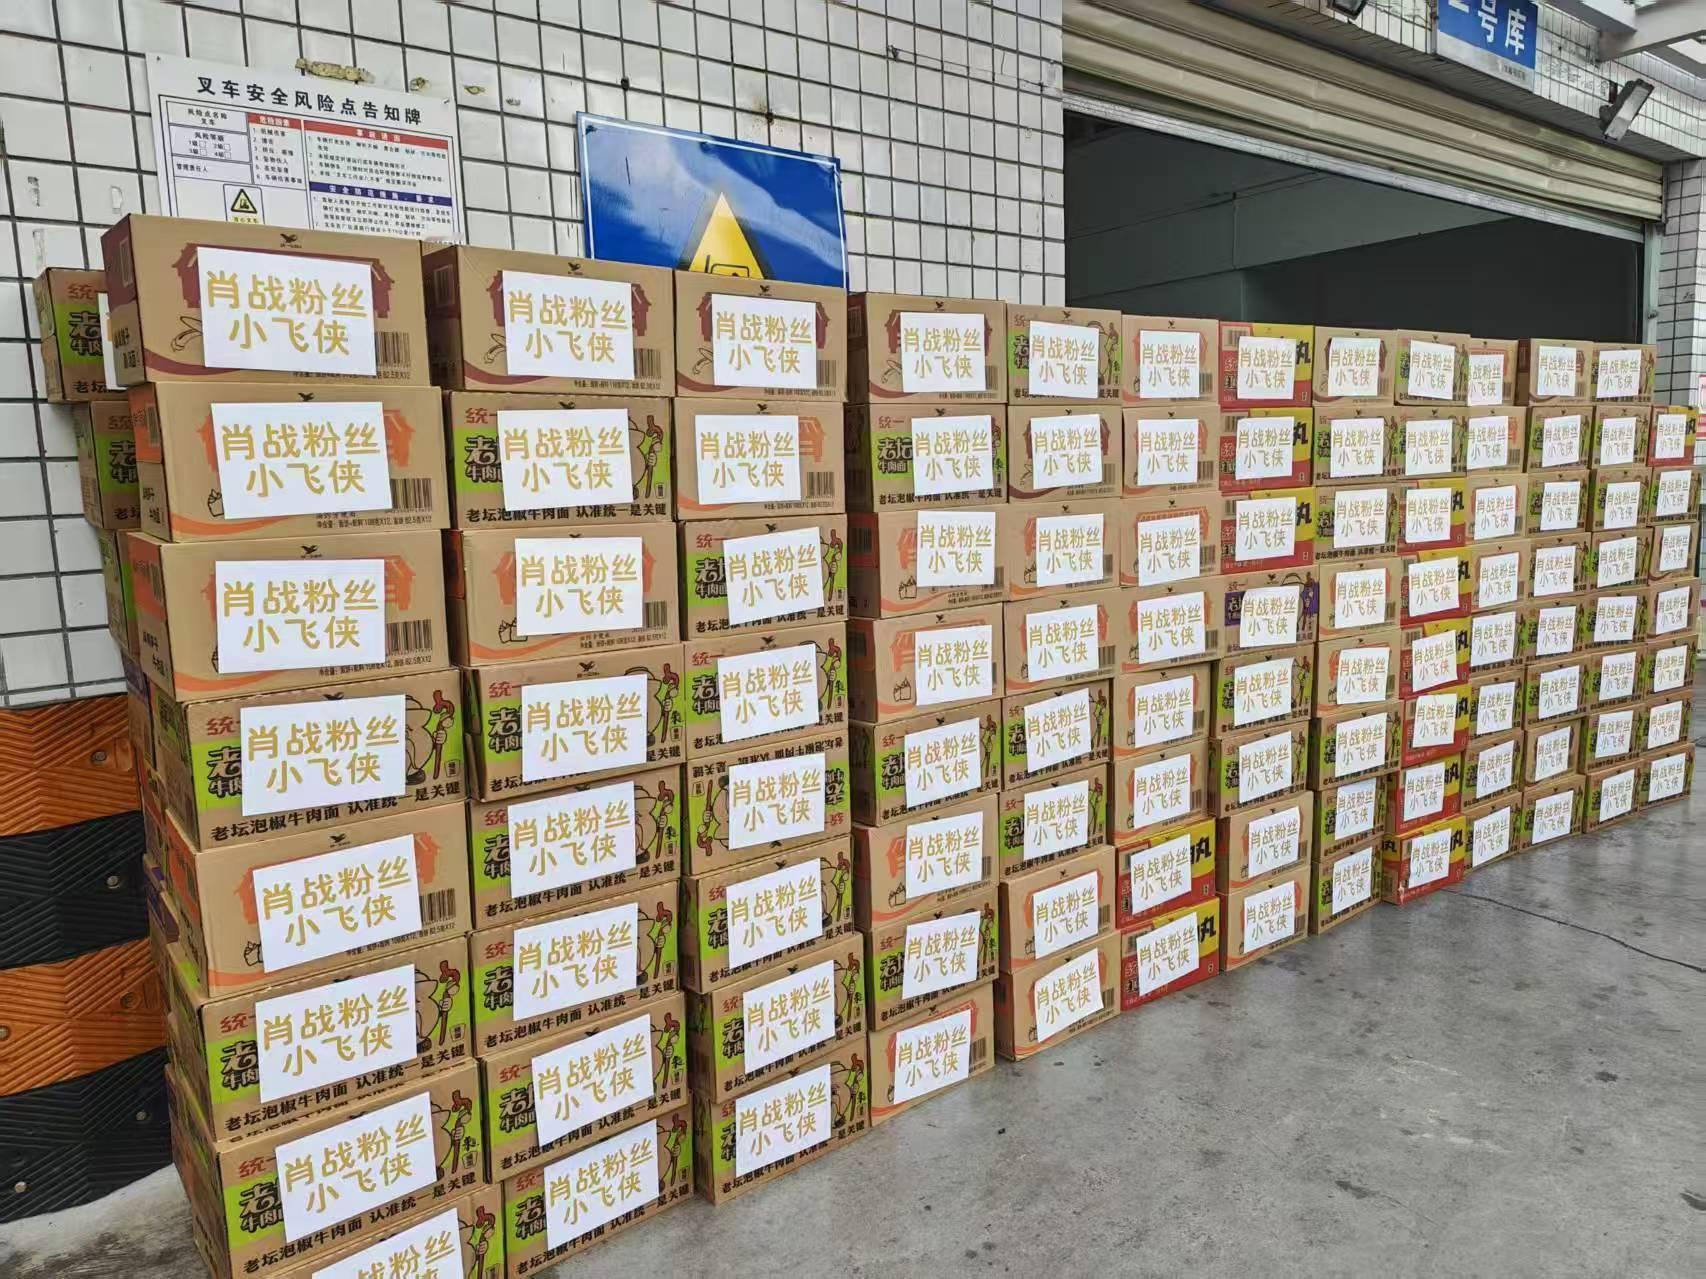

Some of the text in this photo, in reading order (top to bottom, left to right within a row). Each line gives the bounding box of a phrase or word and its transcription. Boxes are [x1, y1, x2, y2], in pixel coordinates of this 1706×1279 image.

[197, 76, 421, 125] 叉车安全风险点告知牌
[206, 270, 368, 319] 肖战粉丝
[508, 289, 629, 331] 肖战粉丝
[228, 312, 350, 356] 小飞侠
[525, 328, 615, 363] 小飞侠
[716, 311, 814, 345] 肖战粉丝
[904, 327, 981, 353] 肖战粉丝
[728, 344, 800, 374] 小飞侠
[914, 354, 973, 379] 小飞侠
[1240, 348, 1293, 368] 肖战粉丝
[1245, 369, 1286, 388] 小飞侠
[221, 421, 381, 462] 肖战粉丝
[878, 416, 904, 428] 统一
[1034, 427, 1099, 454] 肖战粉丝
[466, 436, 499, 464] 老
[504, 426, 625, 462] 肖战粉丝
[700, 431, 795, 461] 肖战粉丝
[914, 429, 989, 457] 肖战粉丝
[246, 458, 366, 498] 小飞侠
[522, 459, 613, 493] 小飞侠
[712, 460, 784, 488] 小飞侠
[925, 455, 981, 481] 小飞侠
[1043, 451, 1091, 476] 小飞侠
[920, 524, 992, 549] 肖战粉丝
[1139, 527, 1198, 554] 肖战粉丝
[521, 554, 638, 588] 肖战粉丝
[728, 543, 818, 583] 肖战粉丝
[928, 549, 983, 574] 小飞侠
[1147, 549, 1191, 574] 小飞侠
[223, 576, 379, 619] 肖战粉丝
[535, 585, 624, 619] 小飞侠
[742, 572, 809, 608] 小飞侠
[243, 615, 360, 653] 小飞侠
[918, 639, 989, 670] 肖战粉丝
[692, 675, 719, 700] 老
[722, 660, 813, 700] 肖战粉丝
[928, 664, 980, 691] 小飞侠
[489, 707, 522, 736] 老
[527, 691, 642, 734] 肖战粉丝
[735, 688, 804, 724] 小飞侠
[1026, 701, 1088, 739] 肖战粉丝
[247, 713, 400, 763] 肖战粉丝
[540, 724, 628, 763] 小飞侠
[907, 732, 977, 771] 肖战粉丝
[1034, 727, 1083, 762] 小飞侠
[266, 751, 381, 794] 小飞侠
[732, 768, 822, 808] 肖战粉丝
[917, 758, 969, 791] 小飞侠
[1136, 766, 1188, 798] 肖战粉丝
[212, 802, 340, 841] 老坛泡椒牛肉面
[744, 797, 810, 832] 小飞侠
[1142, 788, 1182, 816] 小飞侠
[513, 800, 630, 851] 肖战粉丝
[909, 826, 980, 861] 肖战粉丝
[529, 832, 617, 876] 小飞侠
[917, 851, 971, 883] 小飞侠
[261, 856, 412, 921] 肖战粉丝
[730, 875, 818, 927] 肖战粉丝
[284, 893, 397, 947] 小飞侠
[742, 905, 808, 948] 小飞侠
[518, 920, 633, 974] 肖战粉丝
[907, 925, 976, 962] 肖战粉丝
[531, 953, 618, 1000] 小飞侠
[913, 950, 966, 983] 小飞侠
[263, 985, 410, 1052] 肖战粉丝
[485, 979, 674, 1048] 老坛泡椒牛肉面 认准统一是关键
[747, 977, 832, 1033] 肖战粉丝
[282, 1022, 393, 1077] 小飞侠
[758, 1007, 821, 1053] 小飞侠
[897, 1024, 967, 1068] 肖战粉丝
[537, 1033, 647, 1102] 肖战粉丝
[905, 1048, 958, 1087] 小飞侠
[225, 1080, 347, 1132] 老坛泡椒牛肉面
[356, 1044, 465, 1090] 认准统一是关键
[555, 1066, 635, 1121] 小飞侠
[738, 1081, 827, 1137] 肖战粉丝
[283, 1113, 428, 1193] 肖战粉丝
[750, 1111, 816, 1157] 小飞侠
[306, 1152, 413, 1214] 小飞侠
[549, 1137, 655, 1208] 肖战粉丝
[563, 1170, 642, 1225] 小飞侠
[243, 1172, 476, 1274] 老坛泡椒牛肉面 认准统一是关键
[358, 1230, 455, 1279] 战粉丝
